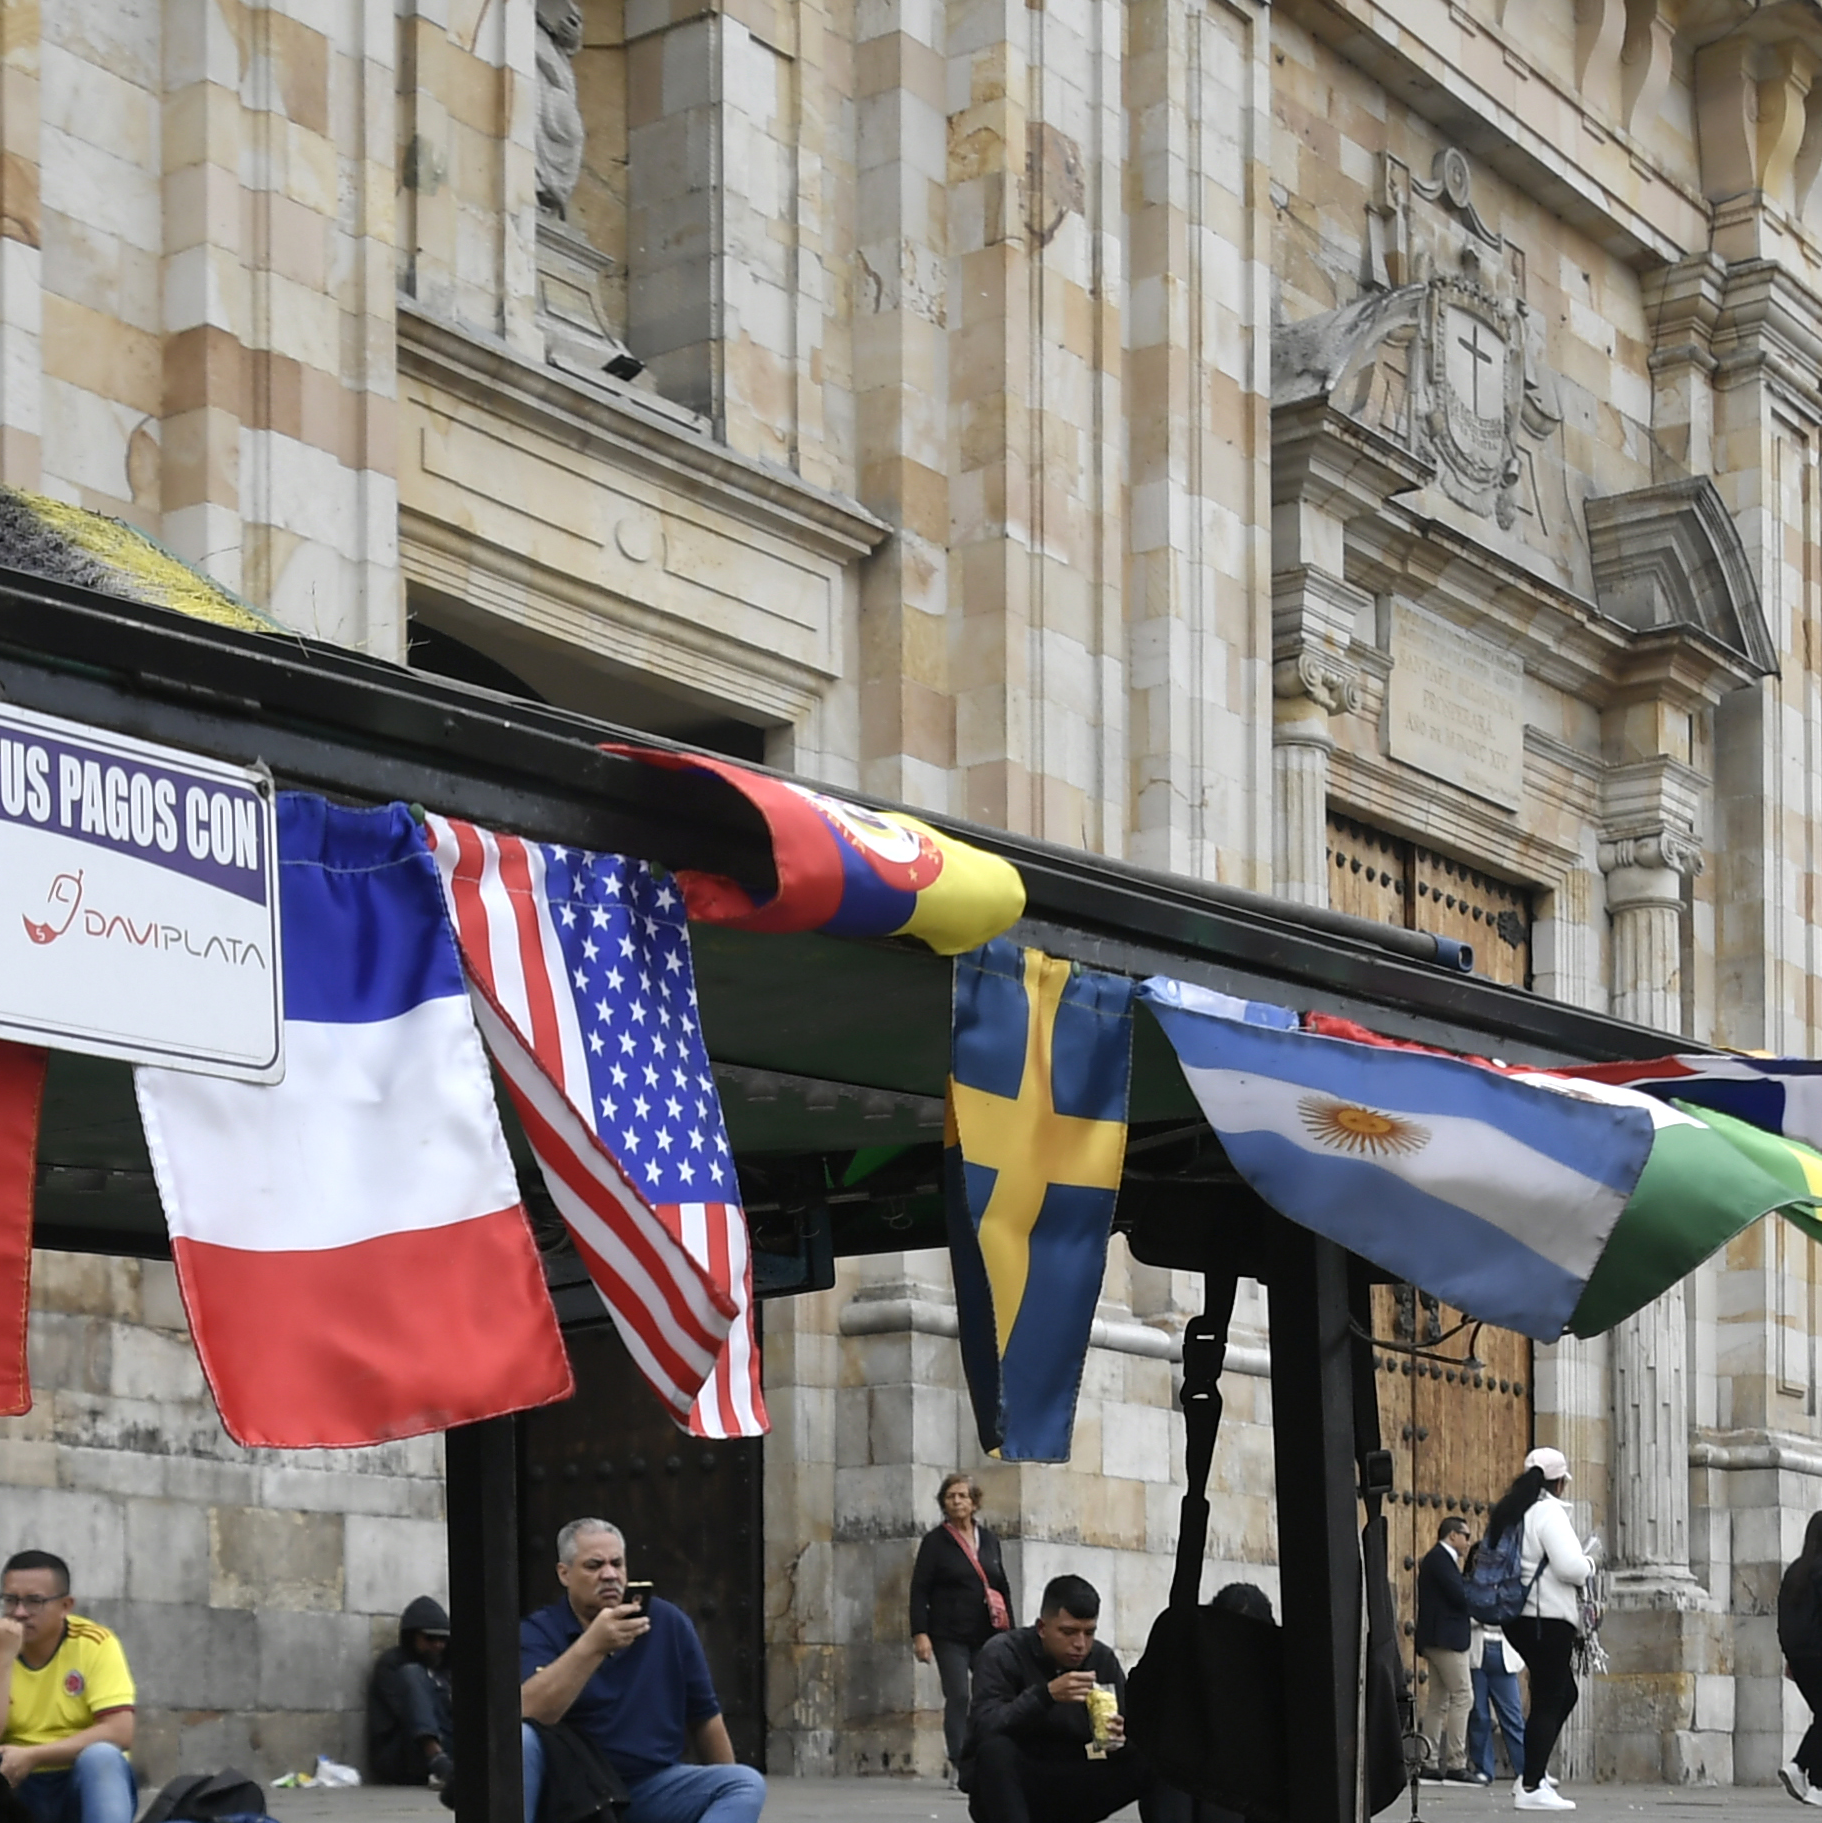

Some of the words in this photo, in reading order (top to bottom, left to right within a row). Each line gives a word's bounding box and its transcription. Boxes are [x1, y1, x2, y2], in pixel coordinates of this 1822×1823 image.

[58, 754, 179, 854] PAGOS
[185, 786, 259, 871] CON
[84, 908, 266, 970] DAVIPLATA
